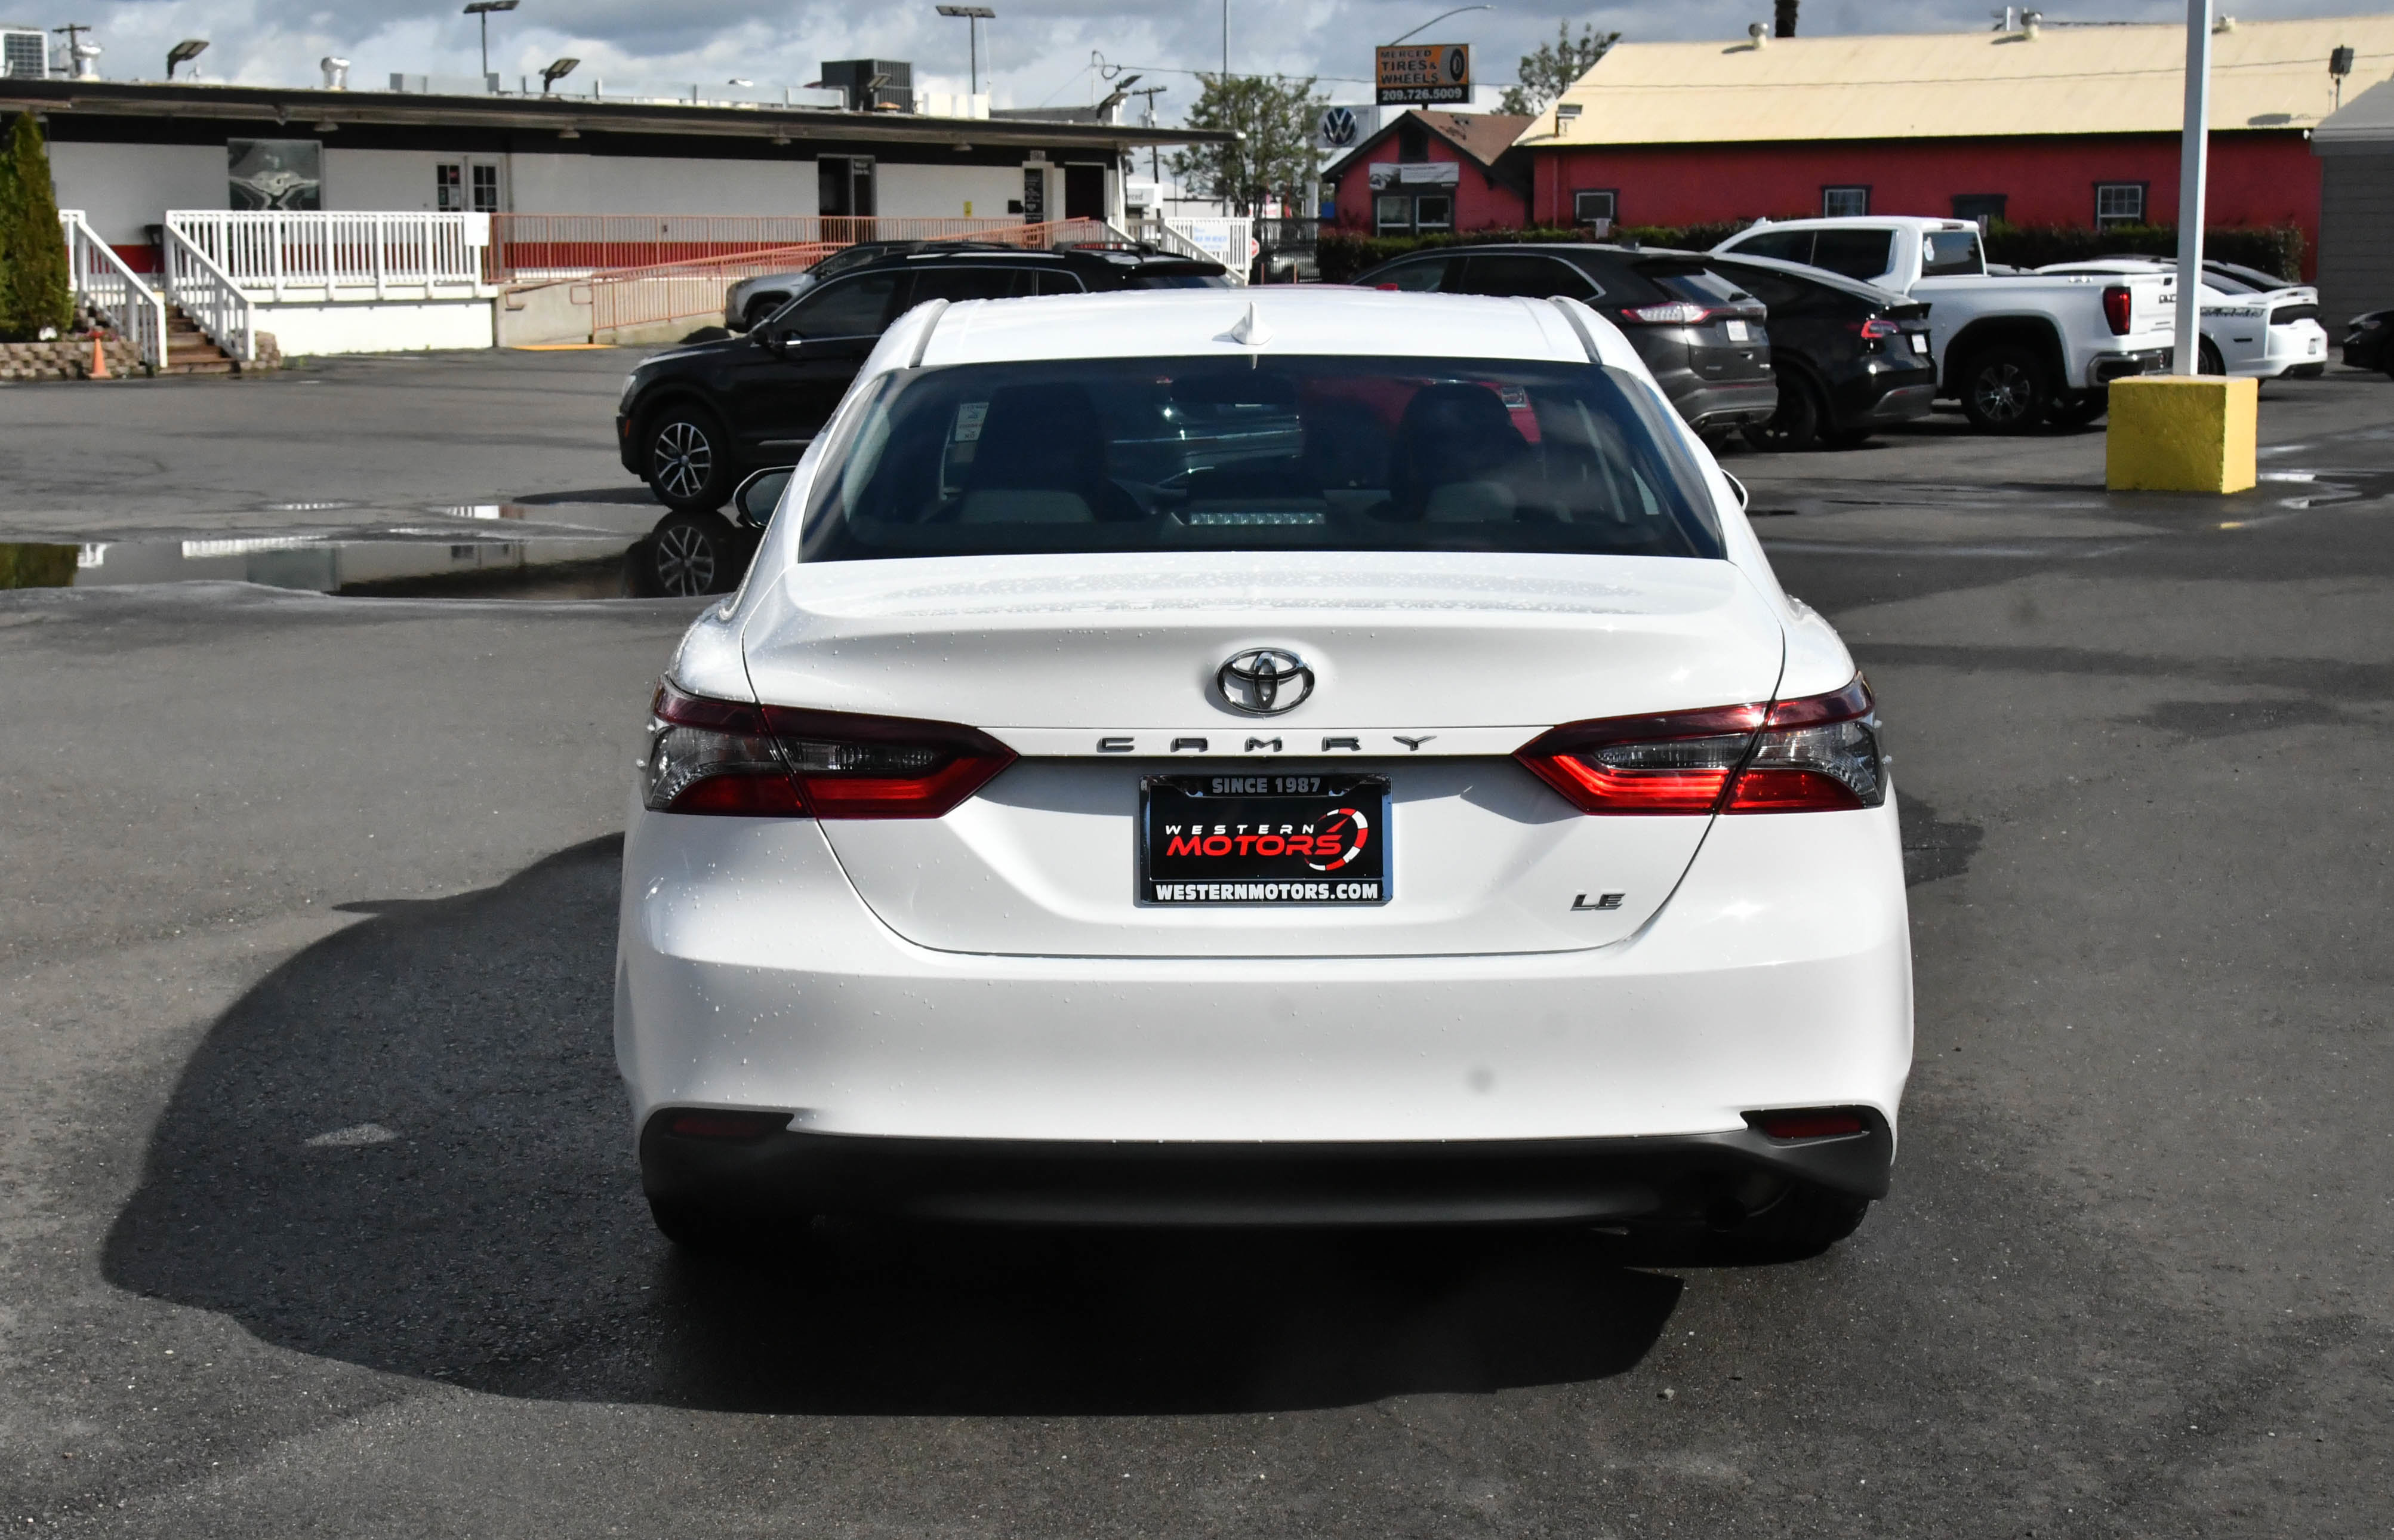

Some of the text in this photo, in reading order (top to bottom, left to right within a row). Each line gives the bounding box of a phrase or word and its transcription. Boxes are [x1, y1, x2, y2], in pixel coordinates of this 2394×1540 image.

[1381, 50, 1431, 58] MERCED
[1381, 60, 1427, 71] TIRES
[1381, 73, 1438, 84] WHEELS
[1382, 87, 1462, 101] 209.726.5009
[1098, 735, 1437, 751] CAMRY
[1212, 778, 1321, 794] SINCE 1987
[1165, 824, 1314, 835] WESTERN
[1166, 834, 1343, 856] MOTORS
[1156, 883, 1378, 901] WESTERNMOTORS.COM
[1570, 893, 1626, 911] LE
